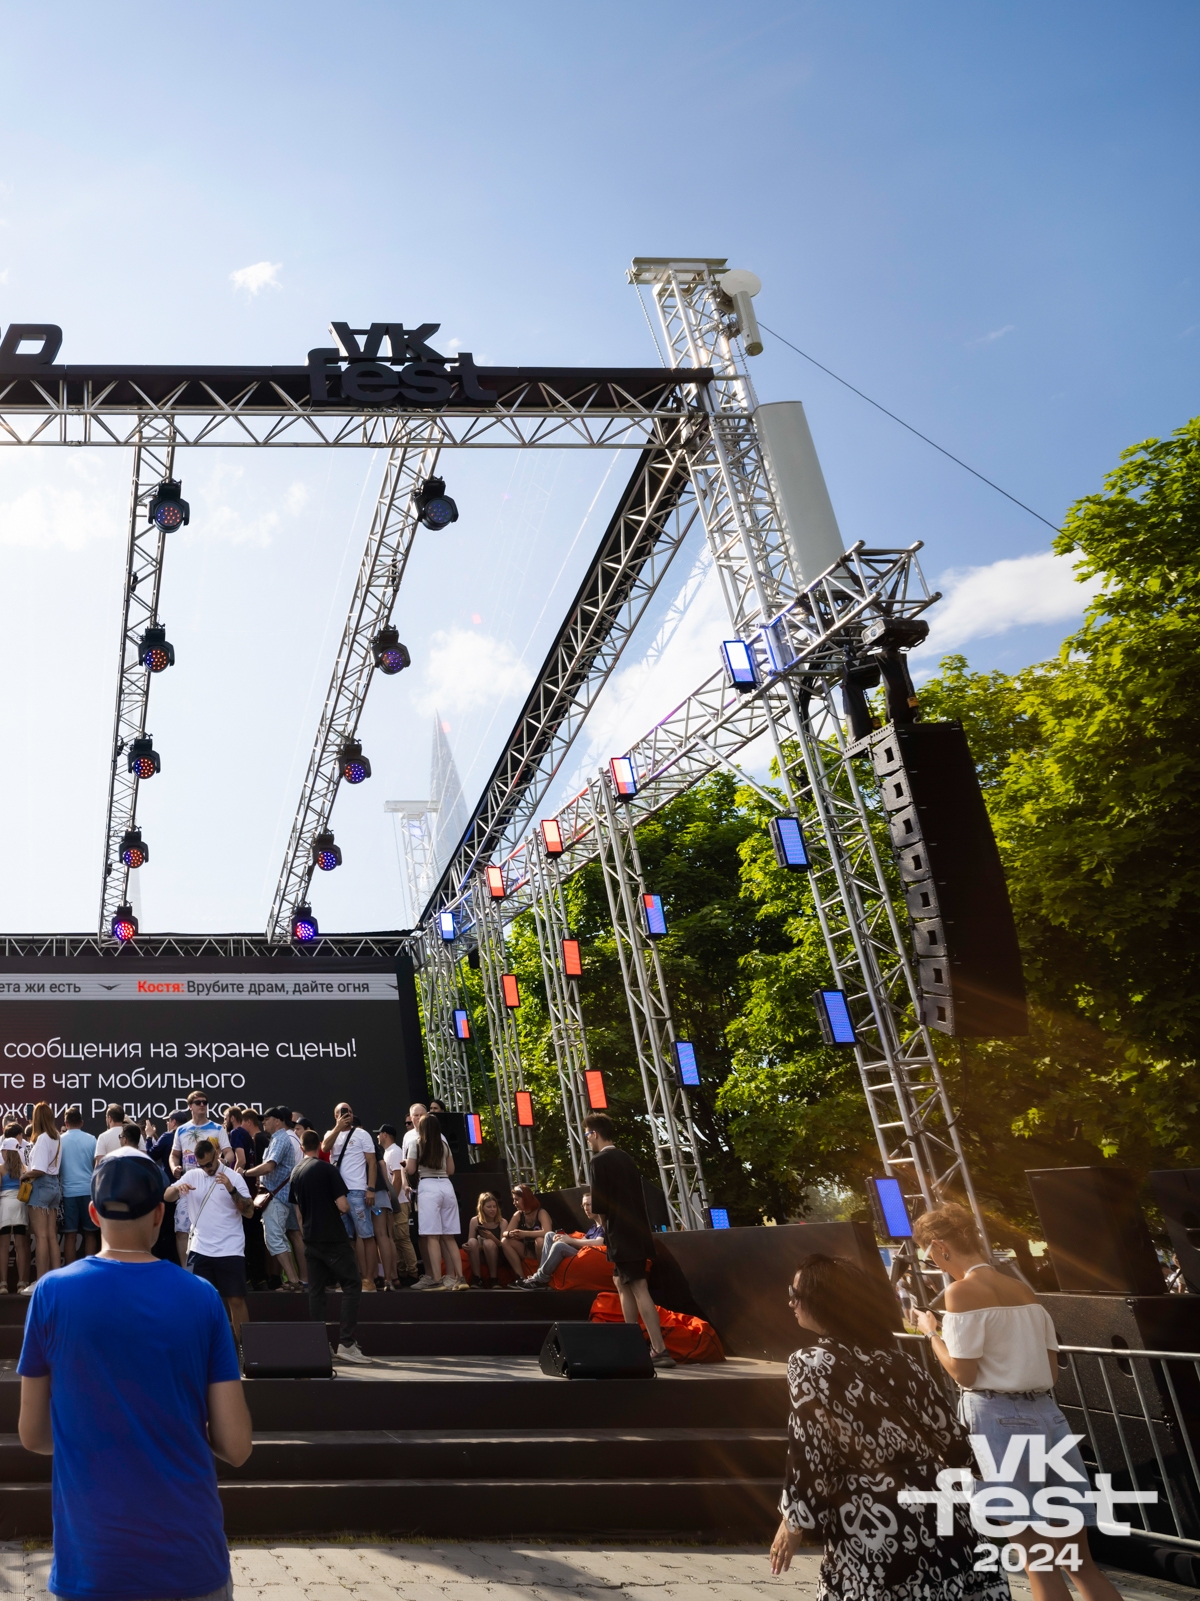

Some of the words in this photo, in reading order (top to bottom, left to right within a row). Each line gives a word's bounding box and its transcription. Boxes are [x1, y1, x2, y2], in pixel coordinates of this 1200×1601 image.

[328, 321, 445, 366] VK
[305, 347, 498, 406] fest
[25, 983, 45, 993] жи
[49, 983, 81, 993] есть
[137, 980, 185, 993] Костя:
[187, 980, 244, 996] Врубите
[248, 982, 289, 996] драм,
[292, 981, 334, 996] дайте
[337, 983, 370, 993] огня
[3, 1037, 142, 1060] сообщения
[150, 1042, 177, 1058] на
[184, 1042, 270, 1062] экране
[276, 1038, 357, 1060] сцены!
[33, 1073, 46, 1088] в
[52, 1073, 92, 1089] чат
[98, 1067, 246, 1089] мобильного
[91, 1098, 168, 1121] Рдио
